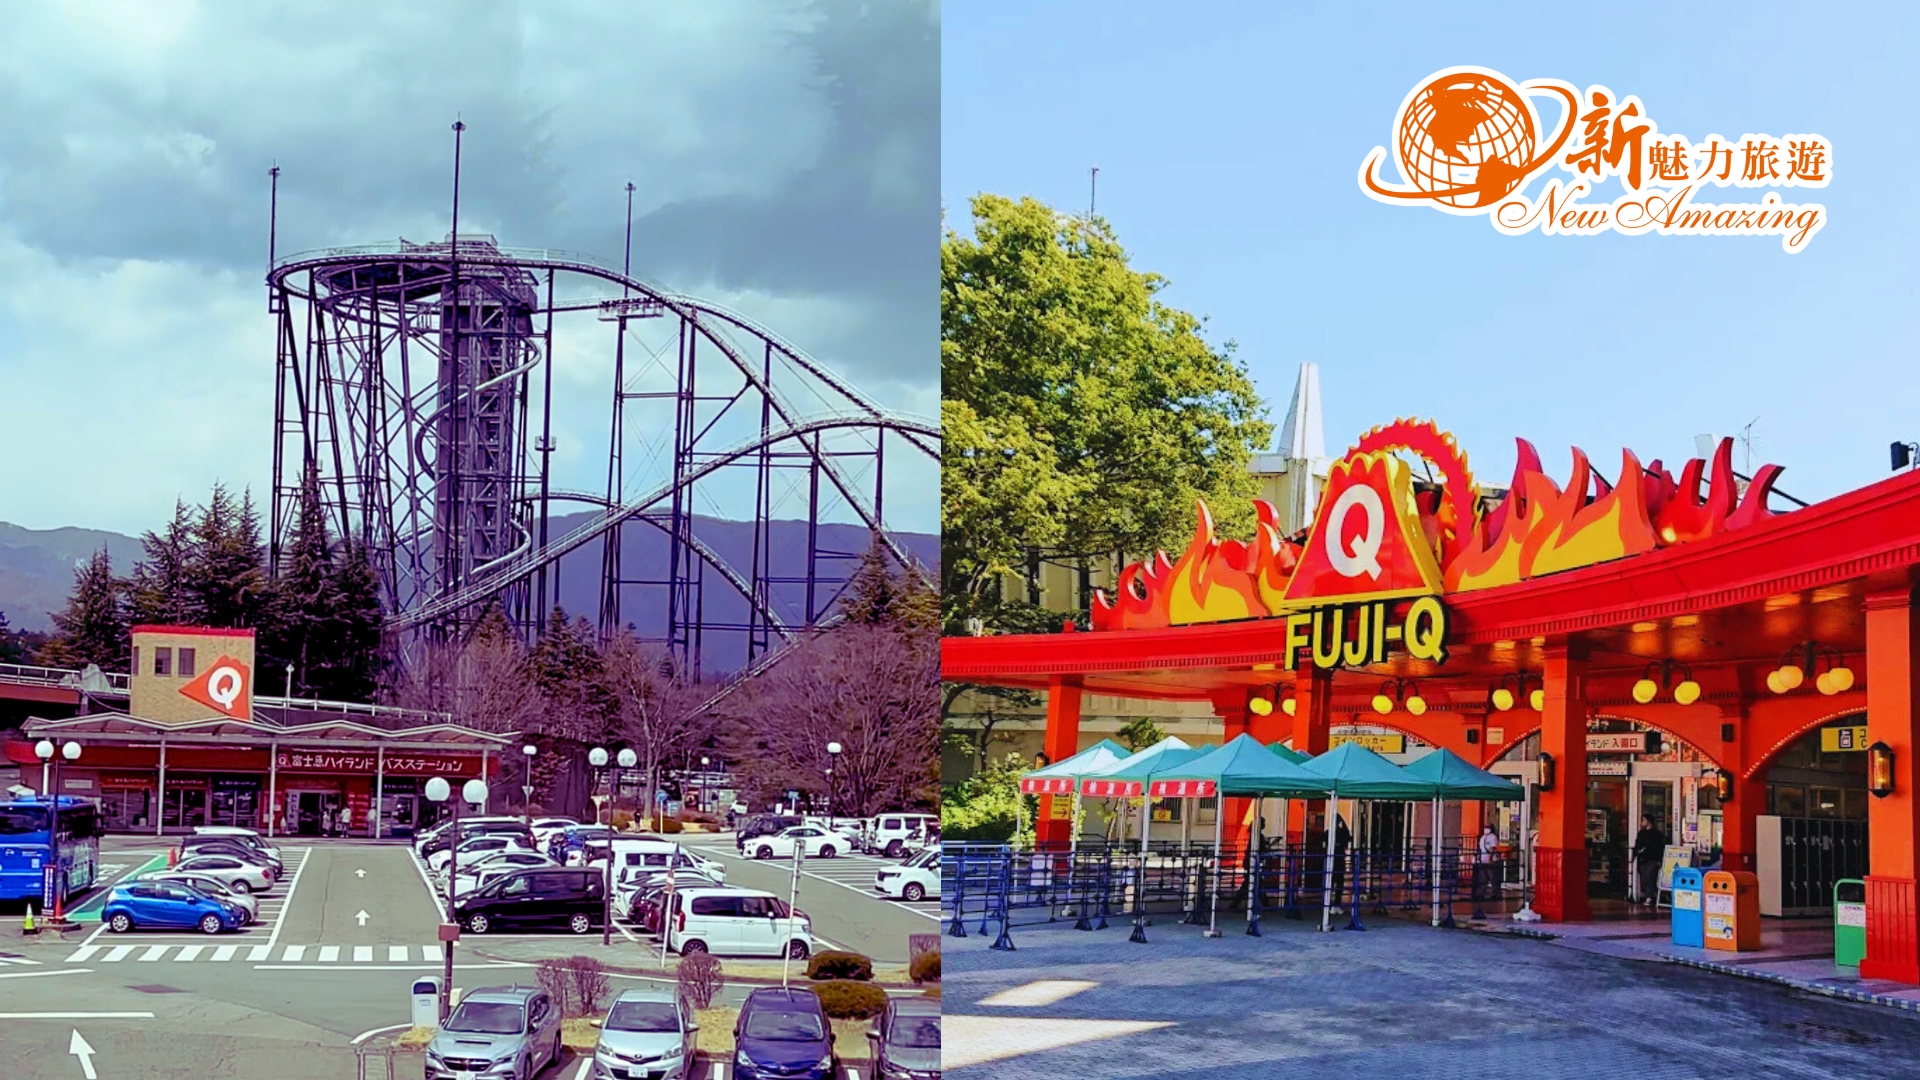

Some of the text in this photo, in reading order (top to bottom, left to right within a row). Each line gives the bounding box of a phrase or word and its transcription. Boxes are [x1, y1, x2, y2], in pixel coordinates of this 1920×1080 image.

[1325, 483, 1386, 582] Q
[1284, 596, 1446, 671] FUJI-Q
[207, 665, 243, 711] Q
[292, 755, 375, 770] 富士急ハイランド
[381, 757, 463, 772] バスステーション
